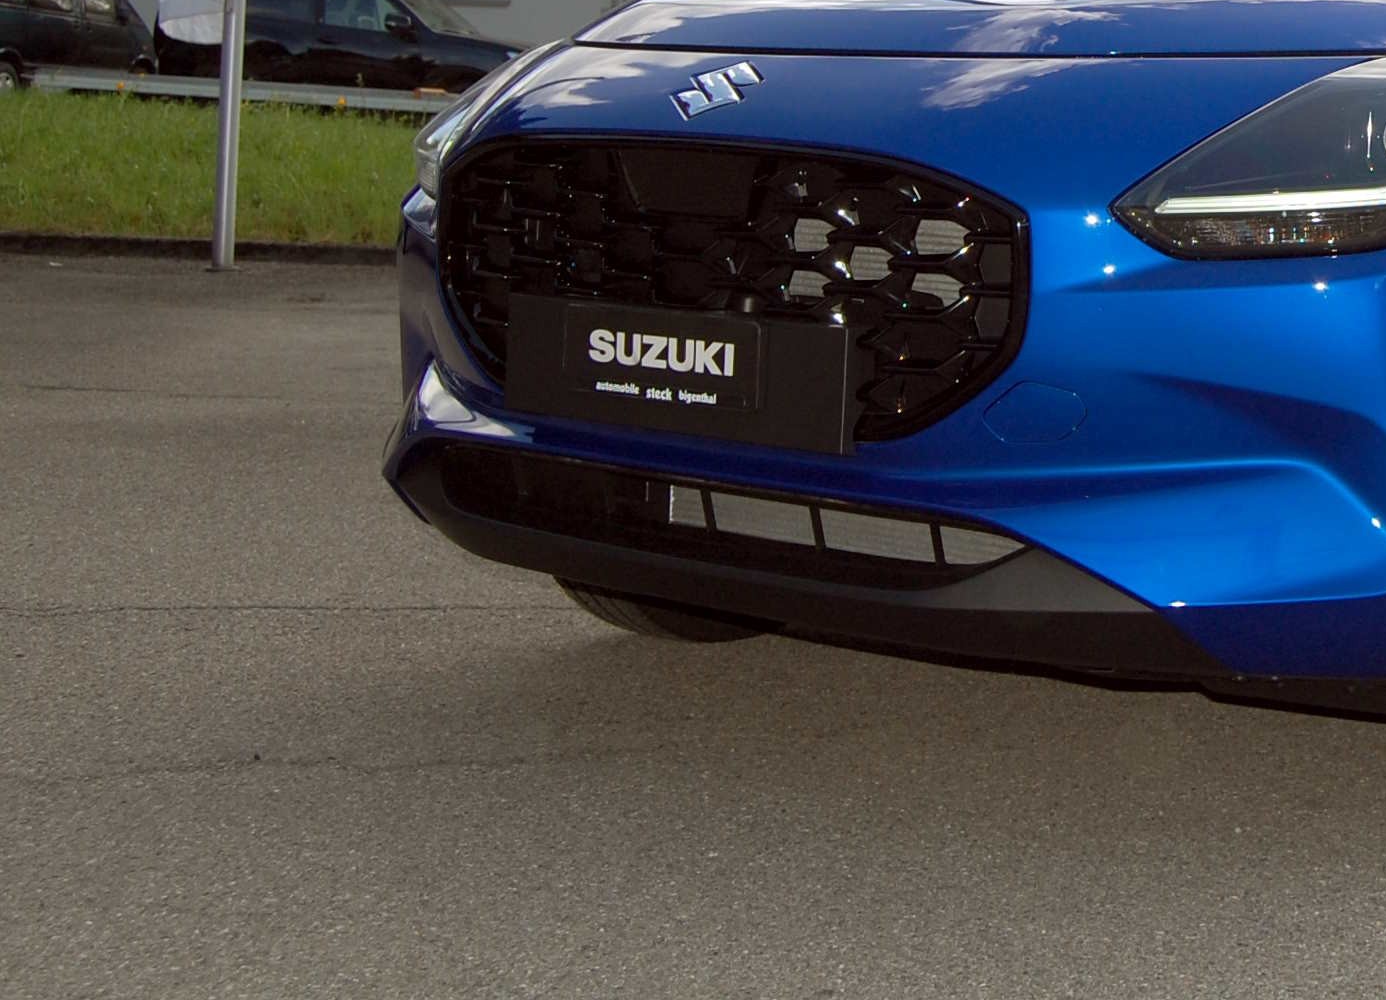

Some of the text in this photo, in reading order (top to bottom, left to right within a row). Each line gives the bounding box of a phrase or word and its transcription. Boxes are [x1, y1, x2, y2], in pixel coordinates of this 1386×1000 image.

[588, 328, 735, 377] SUZUKI
[595, 380, 640, 395] automobile
[645, 387, 673, 401] steck
